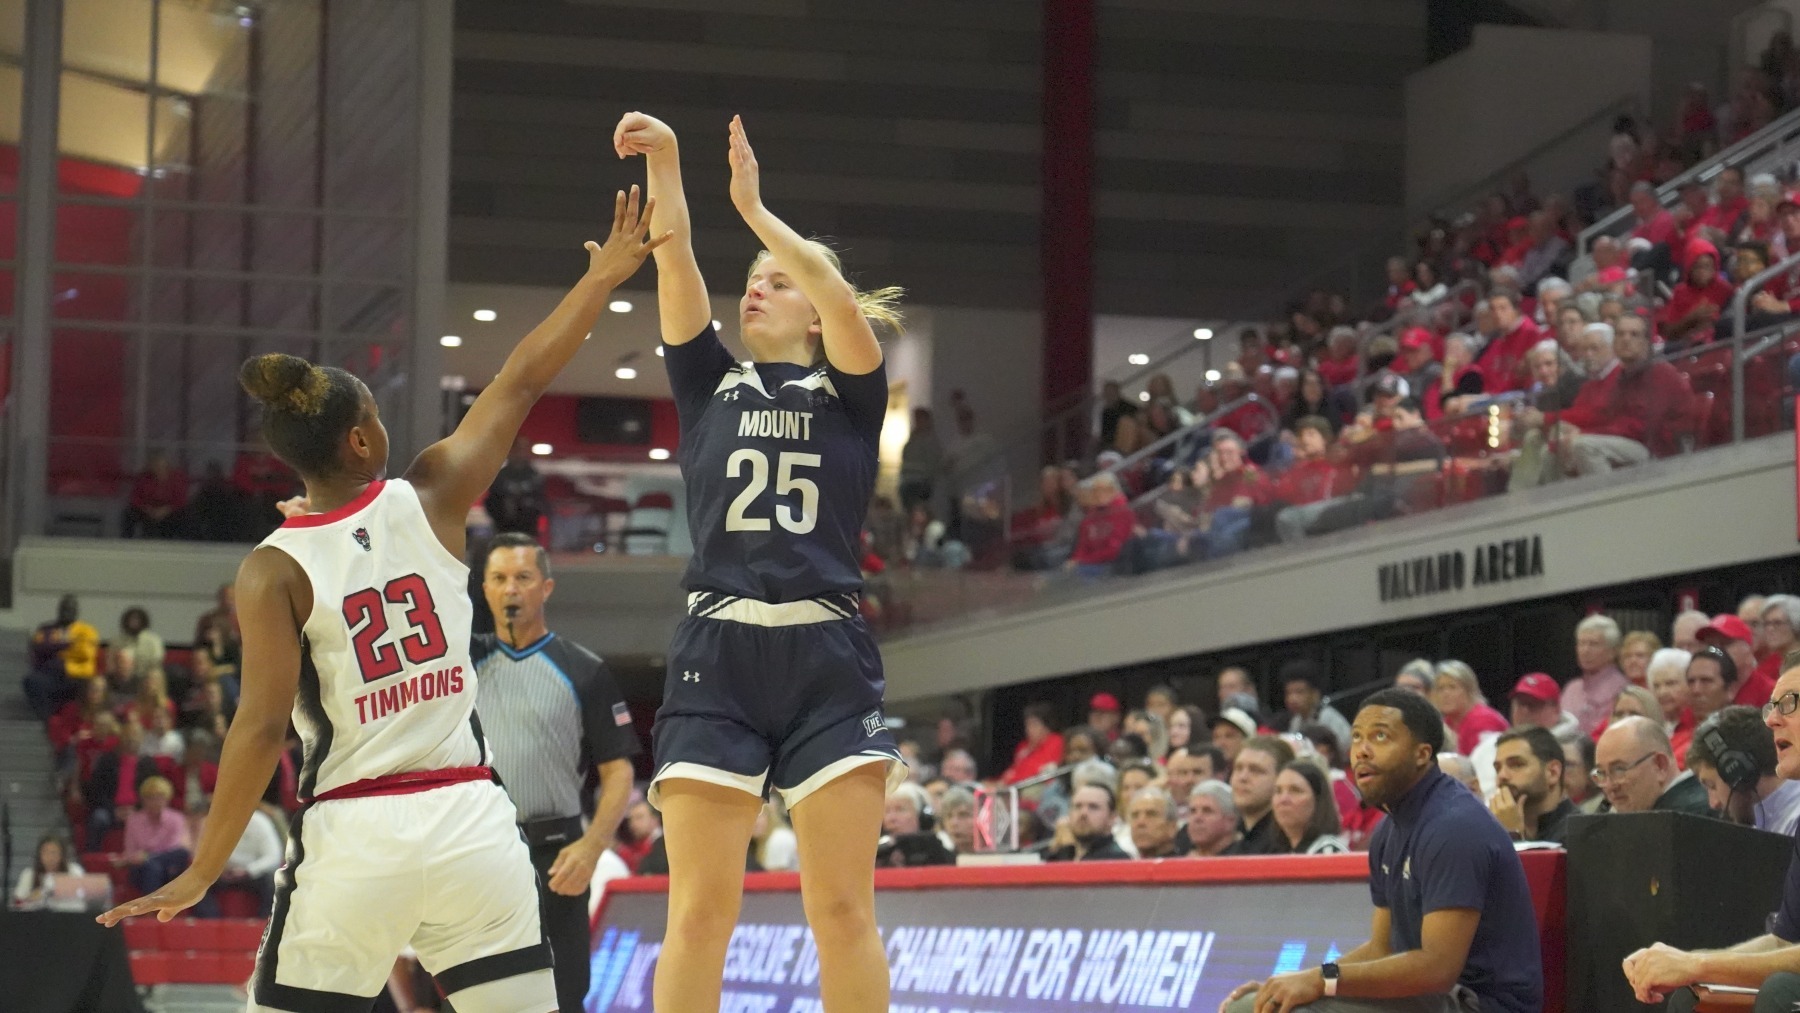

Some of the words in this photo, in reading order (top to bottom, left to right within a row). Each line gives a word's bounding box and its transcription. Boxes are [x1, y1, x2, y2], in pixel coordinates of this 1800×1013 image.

[738, 410, 813, 440] MOUNT
[725, 448, 822, 534] 25
[1378, 549, 1465, 603] VALVANO
[1474, 534, 1544, 586] ARENA
[342, 573, 449, 684] 23
[354, 665, 464, 725] TIMMONS
[865, 716, 882, 733] THE
[722, 925, 804, 984] ESOLVE
[886, 927, 1024, 997] CHAMPION
[1008, 928, 1083, 1001] FOR
[1070, 929, 1215, 1008] WOMEN
